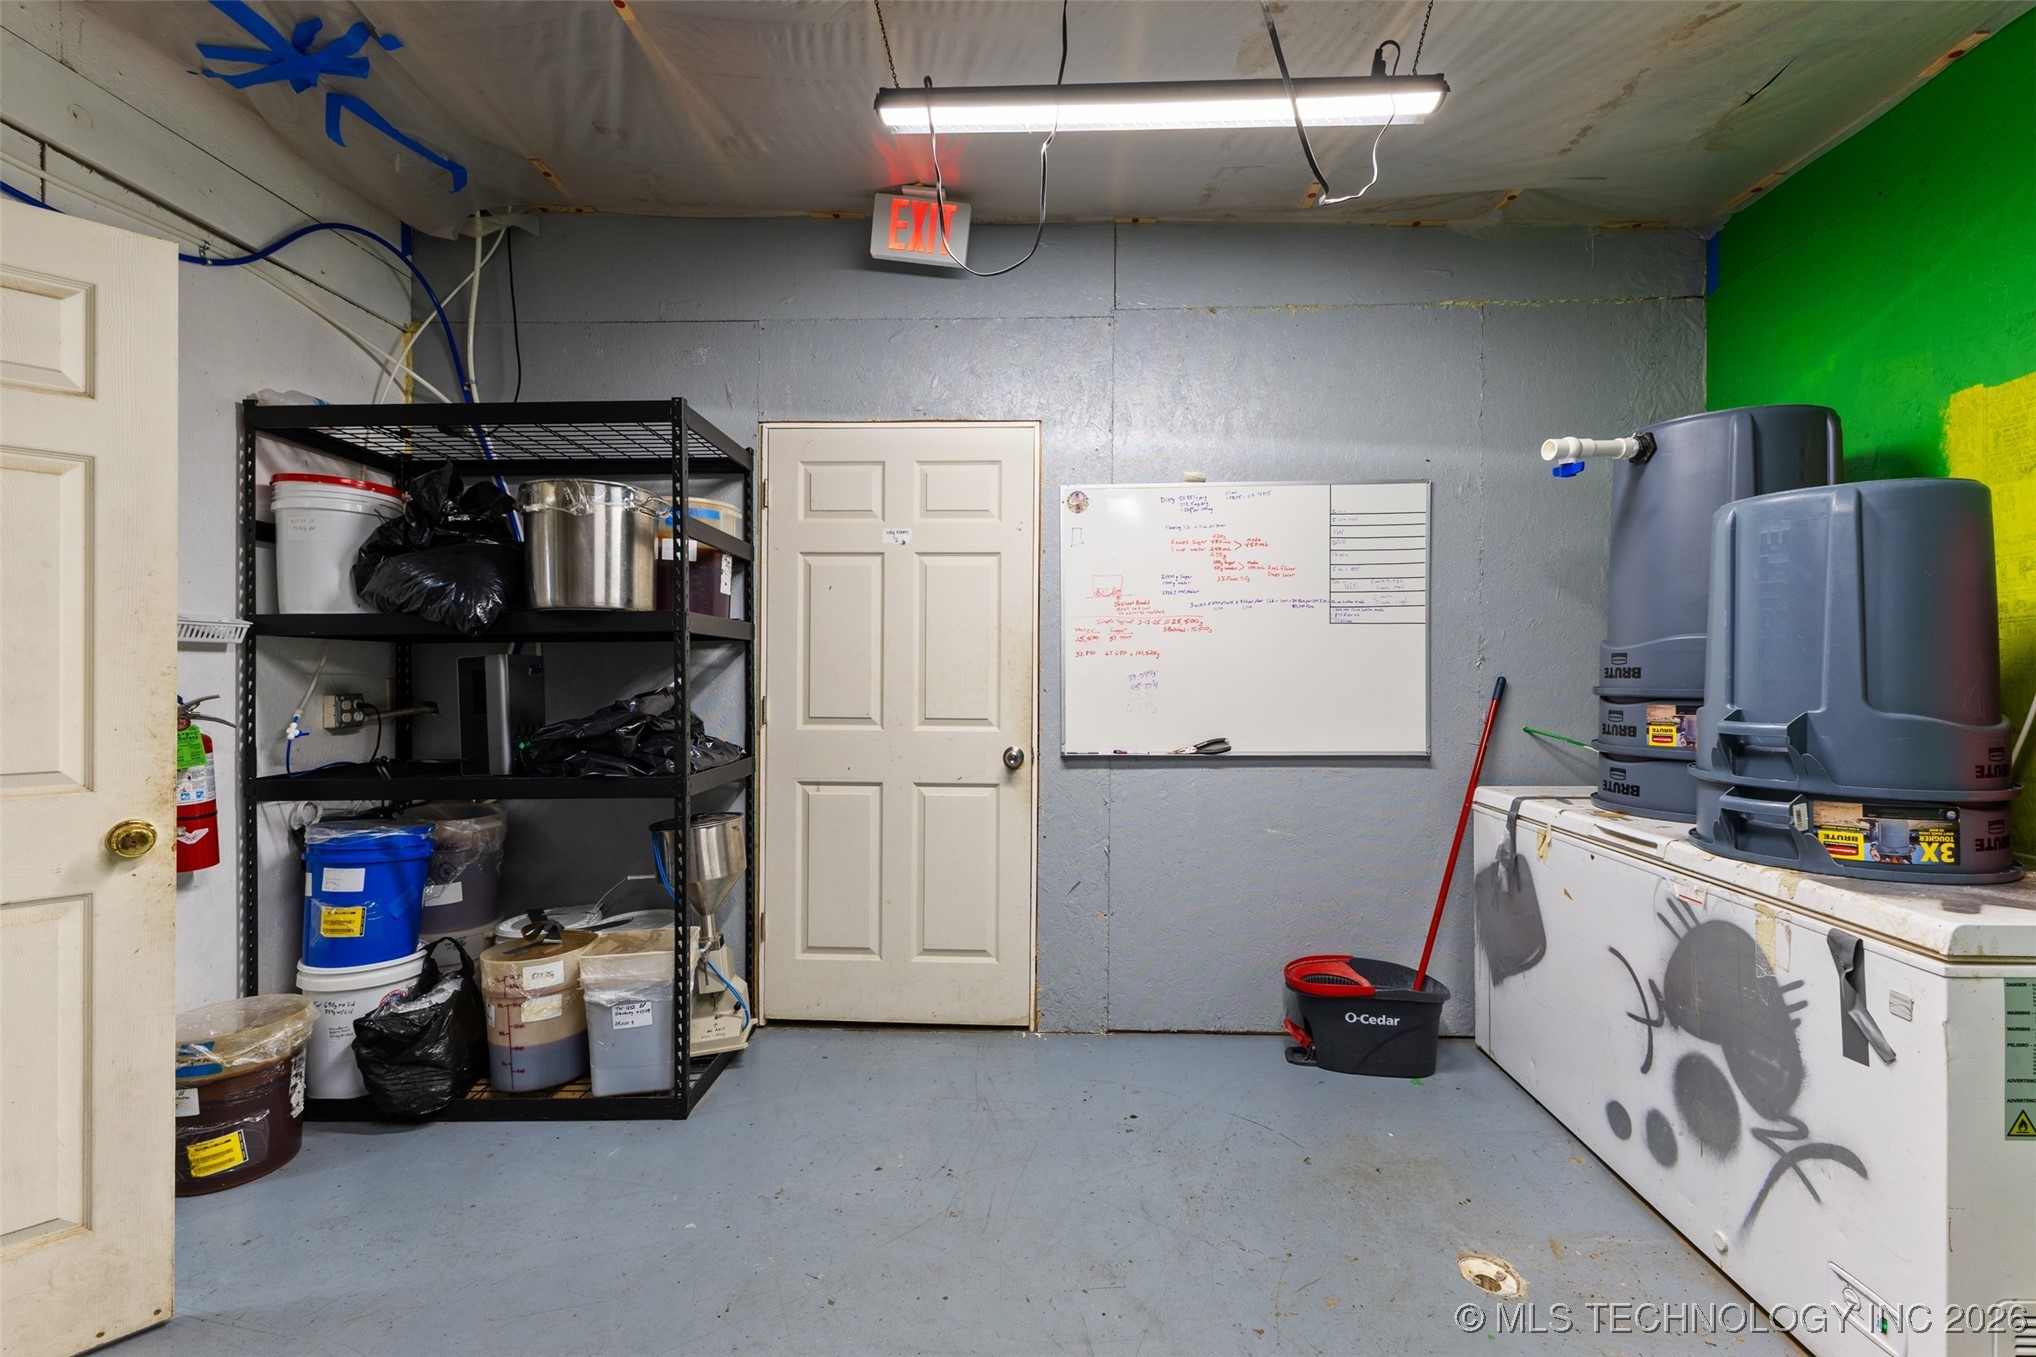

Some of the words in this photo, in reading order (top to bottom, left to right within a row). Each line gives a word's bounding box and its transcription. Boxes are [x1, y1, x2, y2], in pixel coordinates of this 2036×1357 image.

[888, 197, 958, 256] EXIT
[1604, 667, 1642, 679] BRUTE
[1602, 724, 1637, 738] BRUTE
[1975, 764, 2008, 778] RUTE
[1602, 780, 1640, 797] BRUTE
[1823, 834, 1858, 842] BRUTE
[1975, 835, 2010, 852] RUTE
[1920, 842, 1954, 863] 3X
[1344, 1012, 1400, 1026] O-Cedar
